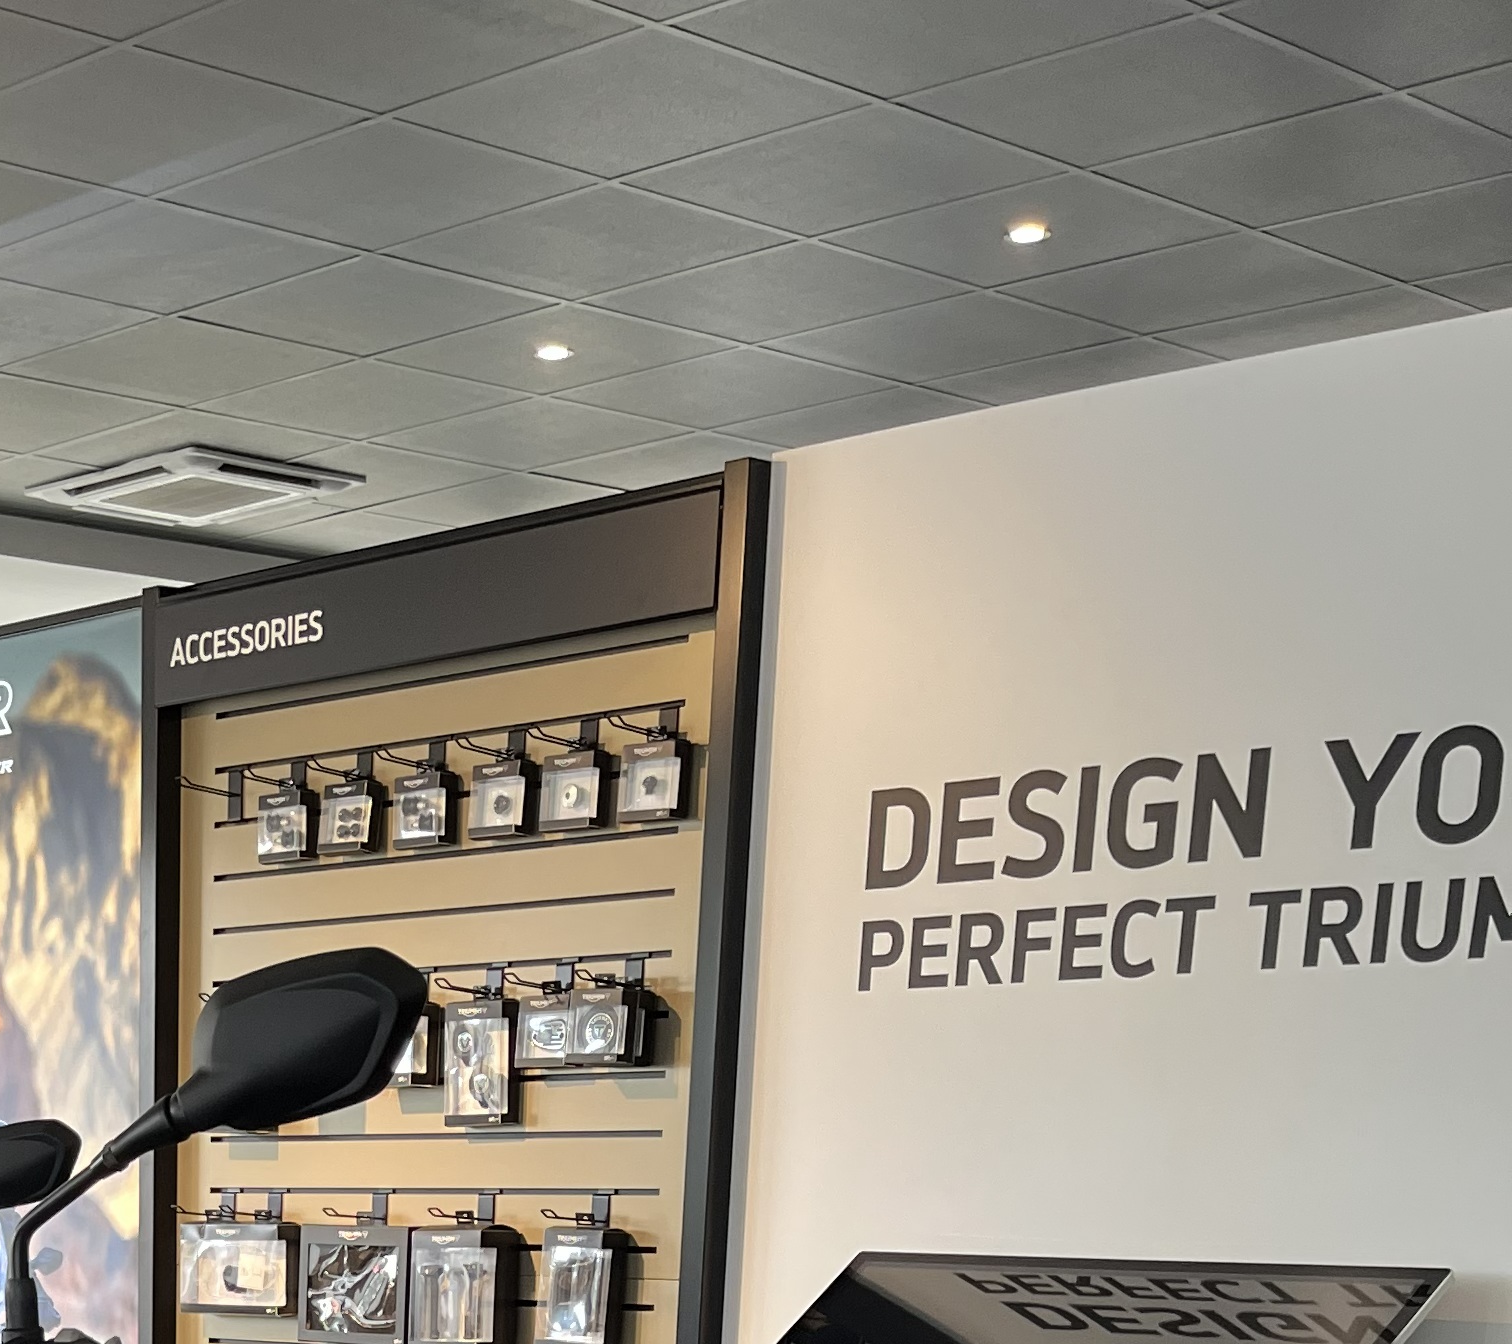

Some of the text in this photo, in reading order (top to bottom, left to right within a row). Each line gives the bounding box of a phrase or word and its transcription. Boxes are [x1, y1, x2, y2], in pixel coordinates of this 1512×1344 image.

[170, 609, 324, 667] ACCESSORIES
[865, 747, 1272, 890] DESIGN
[857, 895, 1217, 991] PERFECT
